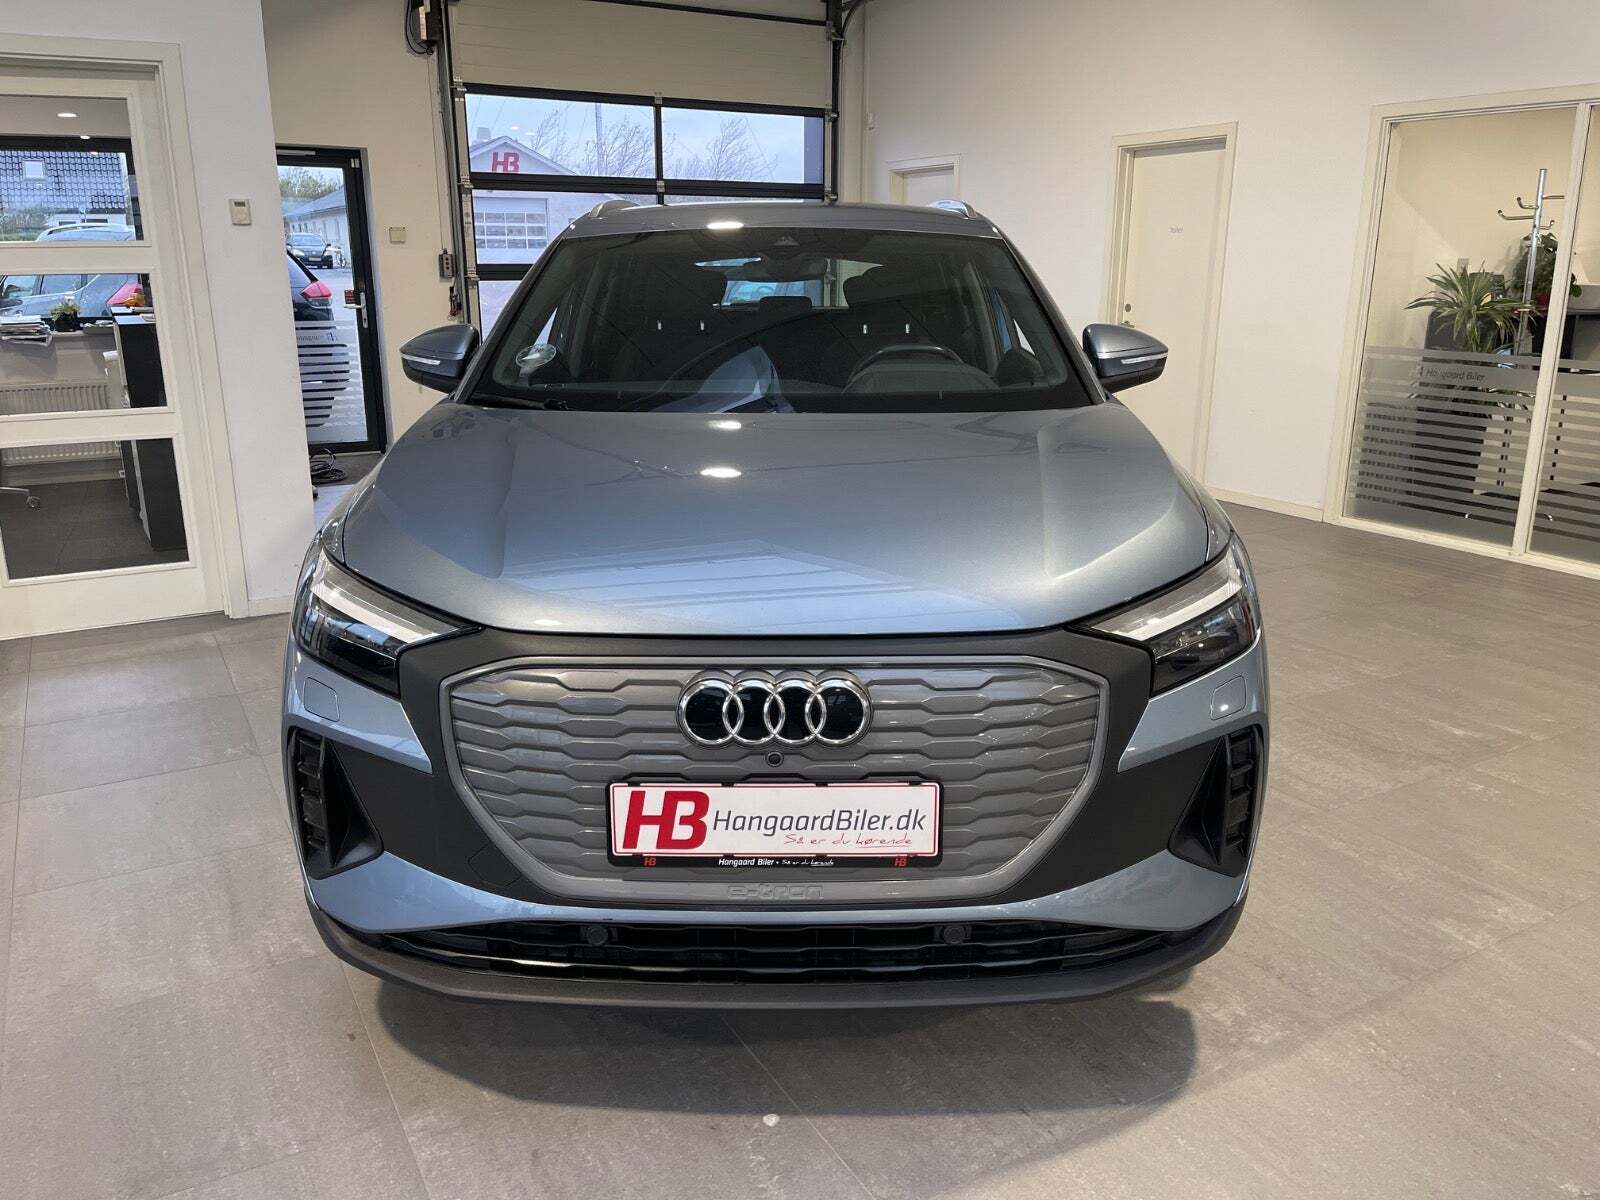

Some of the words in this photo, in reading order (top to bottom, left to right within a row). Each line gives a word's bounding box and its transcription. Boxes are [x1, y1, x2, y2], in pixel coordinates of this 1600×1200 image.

[491, 151, 521, 174] HB
[622, 790, 710, 850] HB
[713, 809, 927, 837] HangaardBiler.dk
[832, 832, 850, 845] du
[855, 832, 912, 846] kørende
[644, 857, 657, 867] HB
[719, 858, 756, 868] Hangaard
[757, 858, 775, 867] Biler
[895, 857, 908, 867] HB
[728, 883, 823, 899] e-tron
